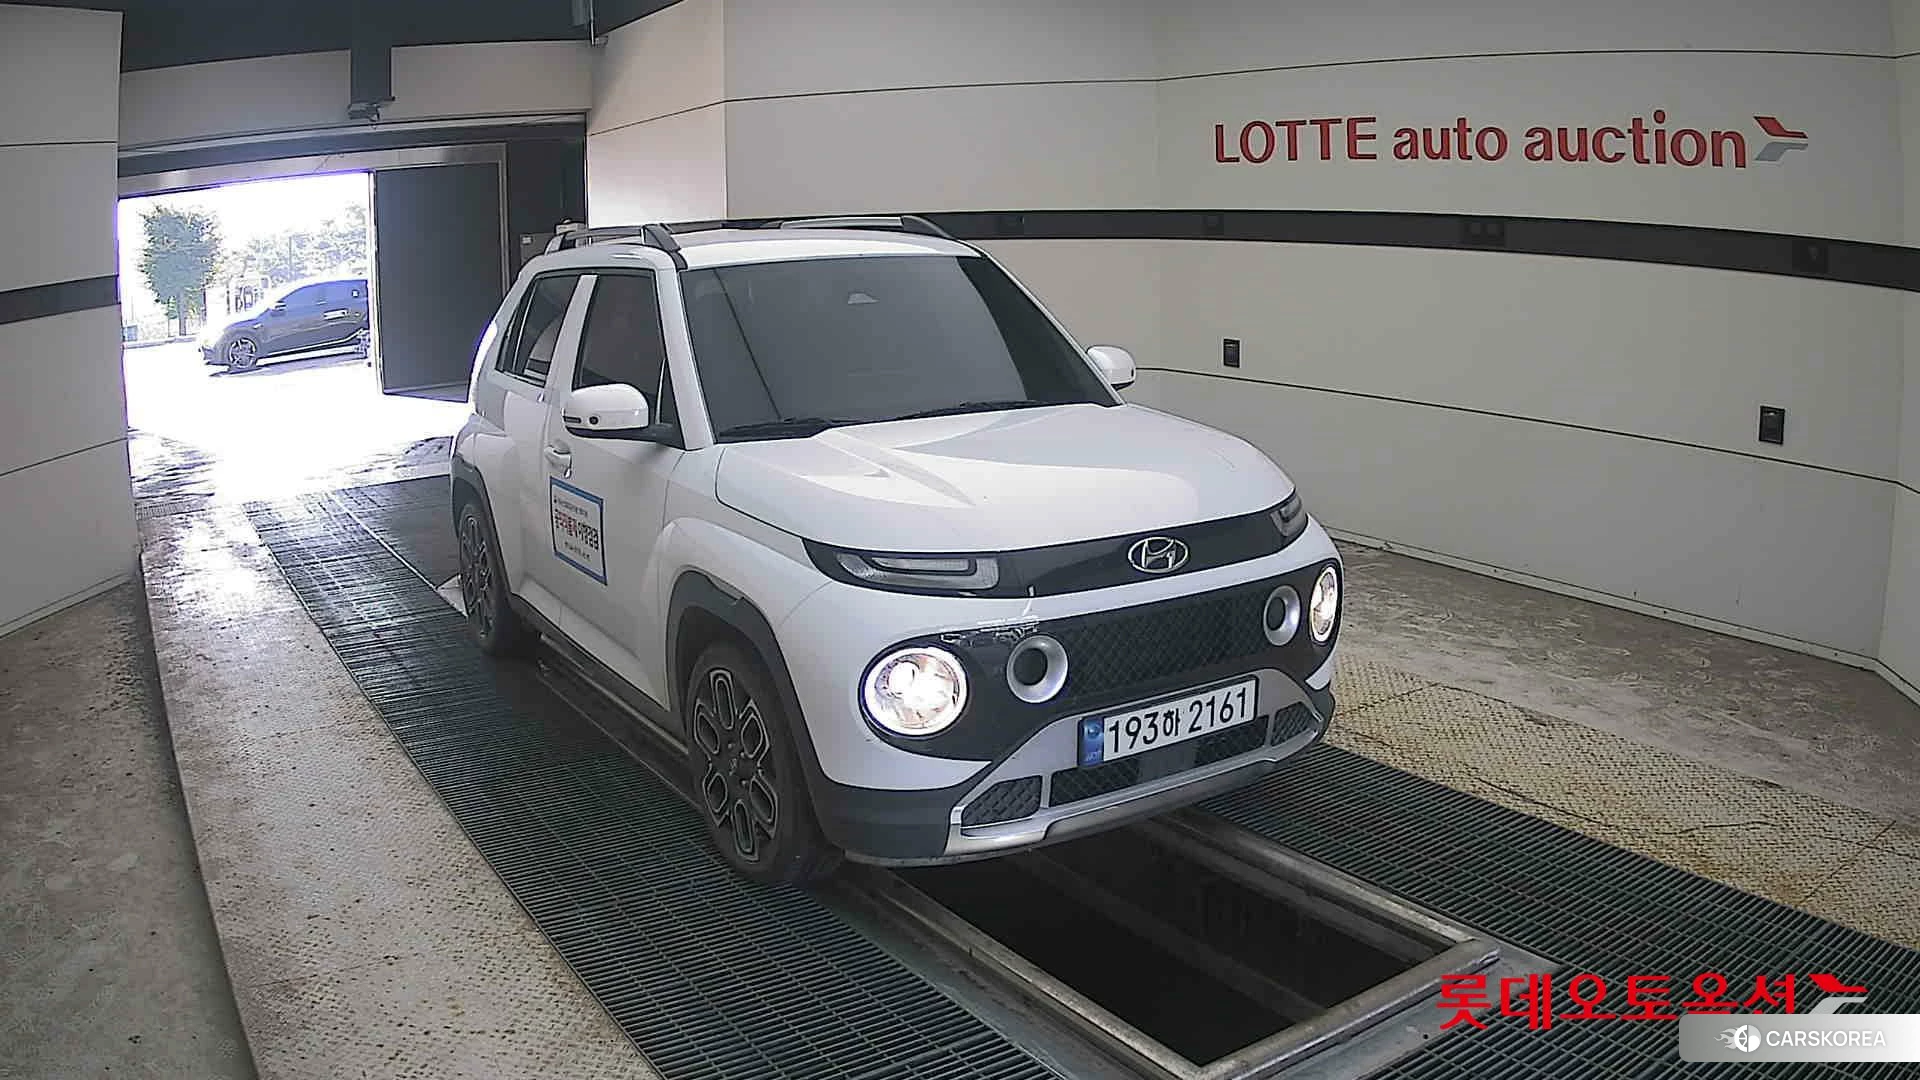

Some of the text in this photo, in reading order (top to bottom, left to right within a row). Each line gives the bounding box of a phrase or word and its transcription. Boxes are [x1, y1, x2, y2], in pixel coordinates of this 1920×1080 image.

[1214, 109, 1748, 169] LOTTE auto auction
[1108, 687, 1247, 753] 193하 2161
